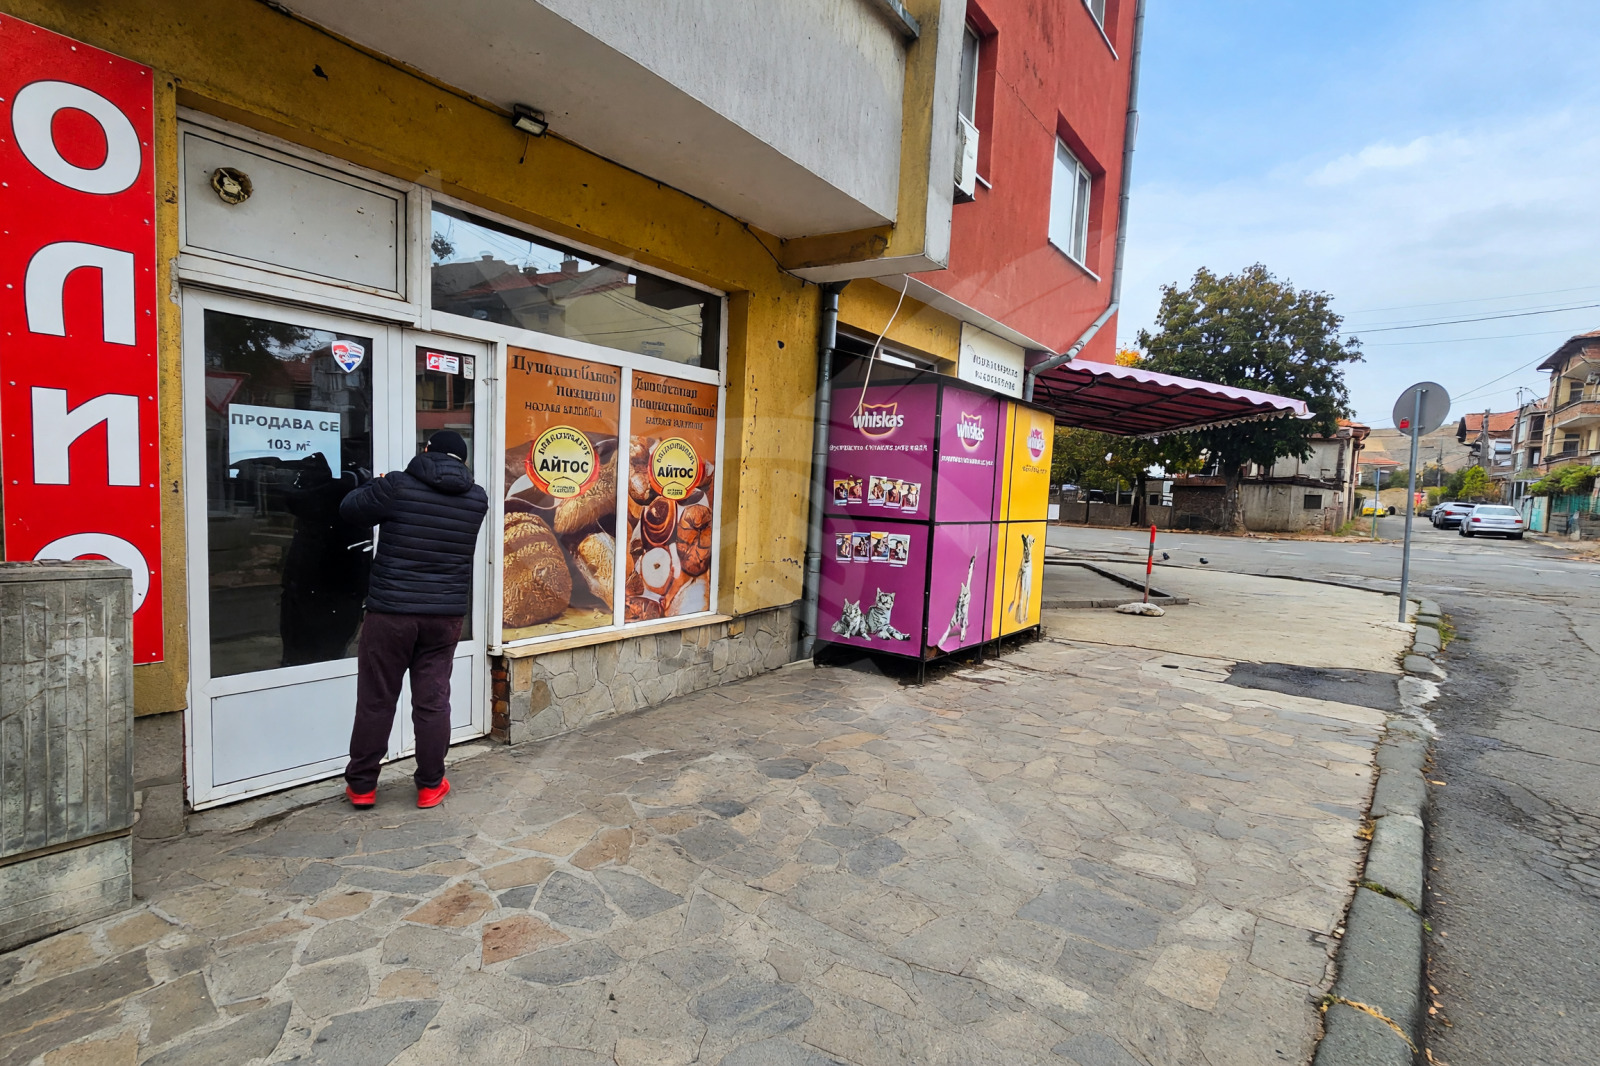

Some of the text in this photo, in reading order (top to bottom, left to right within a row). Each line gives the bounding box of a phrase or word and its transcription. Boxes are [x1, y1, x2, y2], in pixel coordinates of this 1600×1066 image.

[231, 413, 340, 433] ПРОДАВА СЕ
[853, 411, 904, 428] whiskas
[267, 439, 292, 451] 103
[539, 455, 589, 473] АЙТОС
[657, 464, 694, 478] АЙТОС
